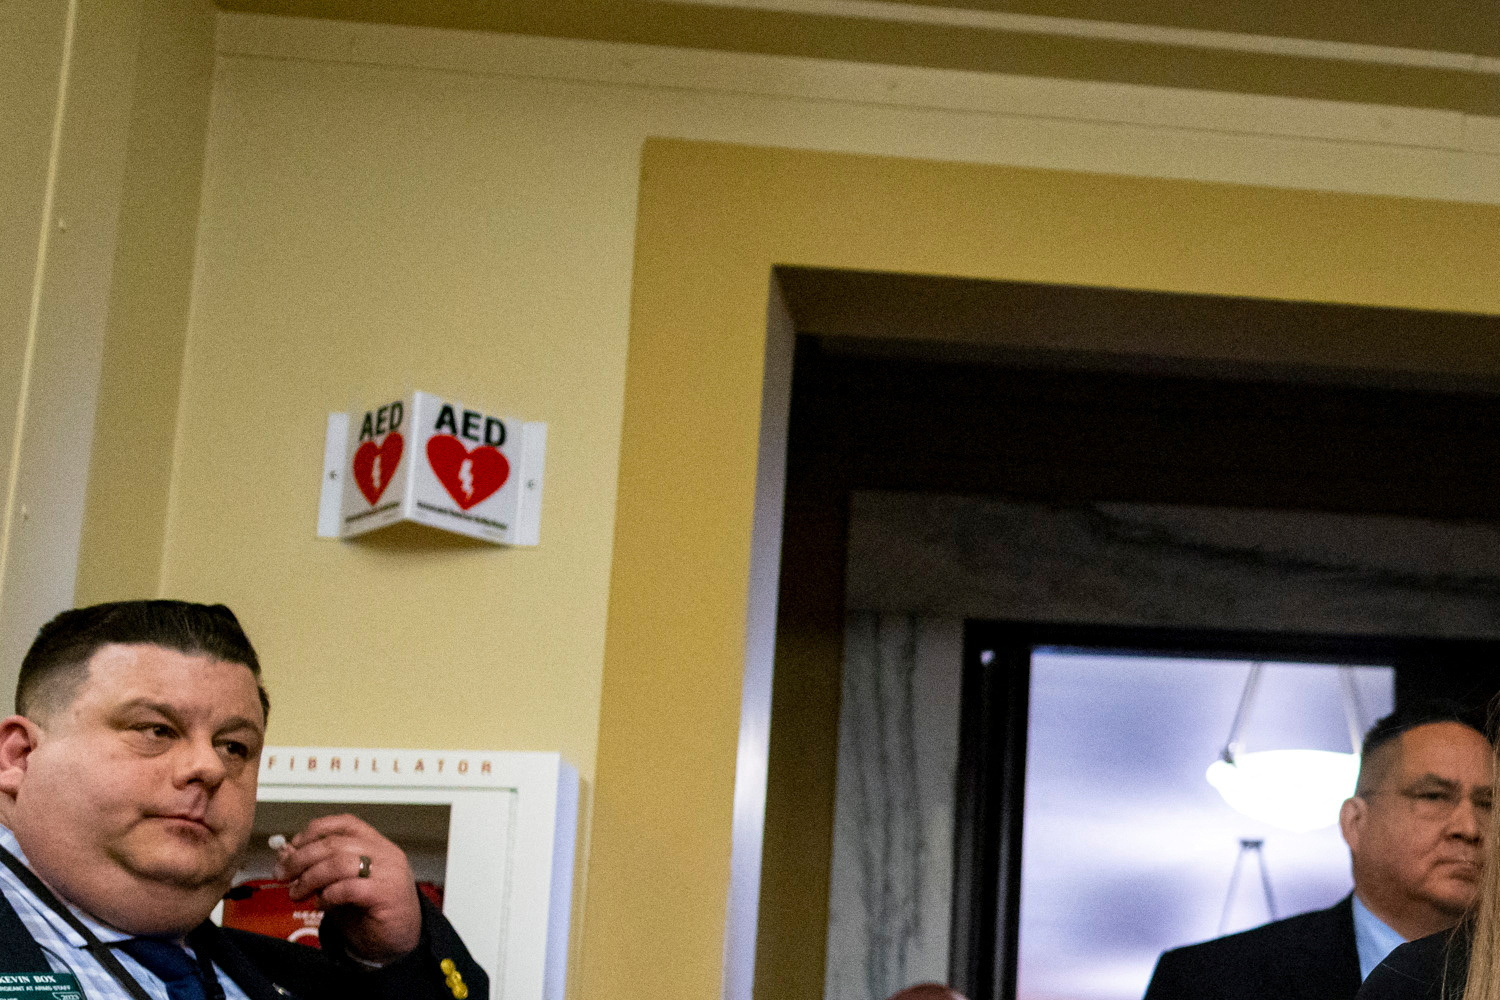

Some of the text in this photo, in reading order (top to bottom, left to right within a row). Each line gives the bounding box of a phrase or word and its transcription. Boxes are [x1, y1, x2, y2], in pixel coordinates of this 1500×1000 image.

[358, 401, 404, 441] AED
[435, 403, 507, 448] AED
[0, 975, 56, 983] KEVIN BOX
